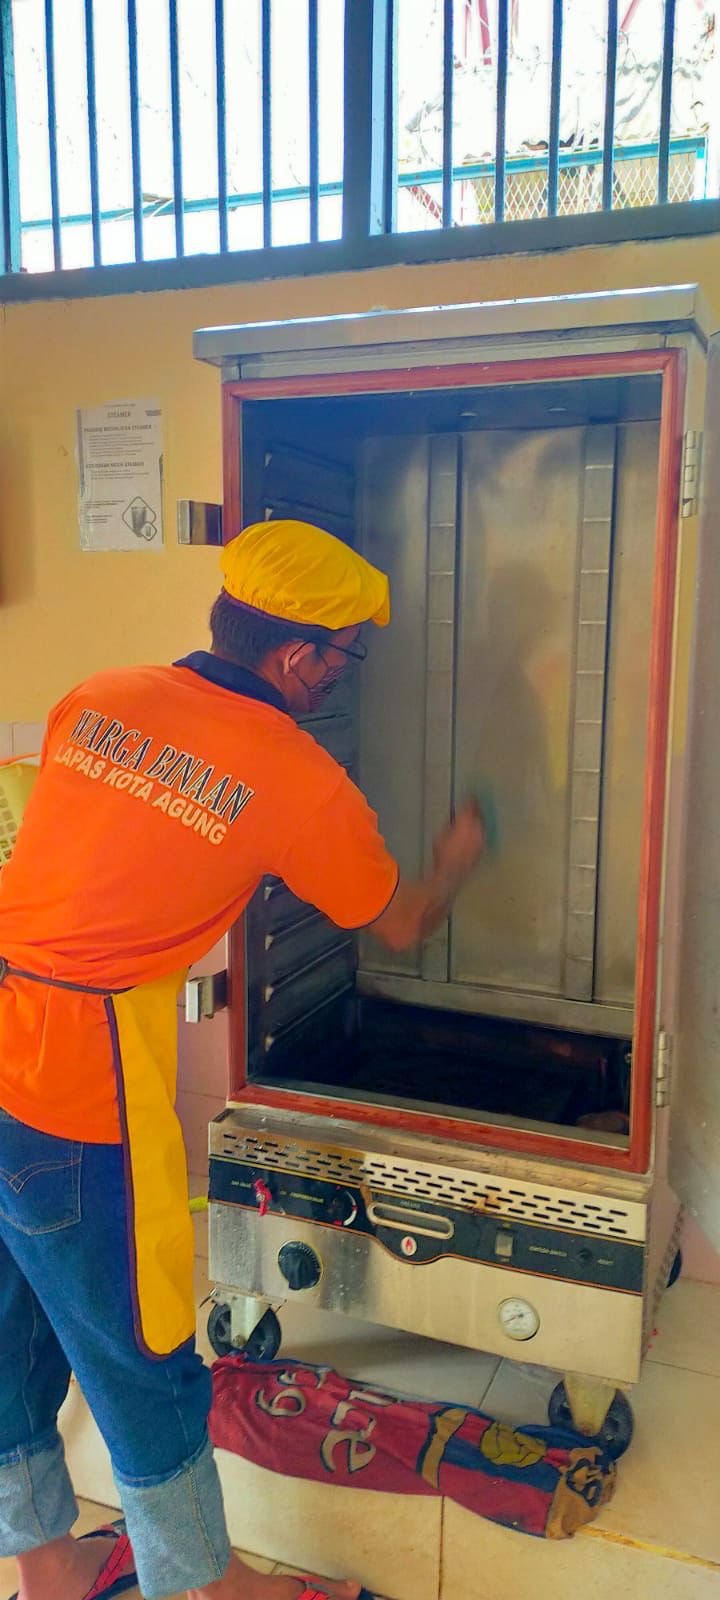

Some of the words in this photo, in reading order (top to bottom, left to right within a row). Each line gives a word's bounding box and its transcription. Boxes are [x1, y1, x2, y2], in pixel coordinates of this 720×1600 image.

[54, 744, 105, 779] LAPAS
[102, 766, 153, 802] KOTA
[152, 791, 227, 845] AGUNG
[67, 708, 152, 773] WARGA
[145, 744, 255, 825] BINAAN
